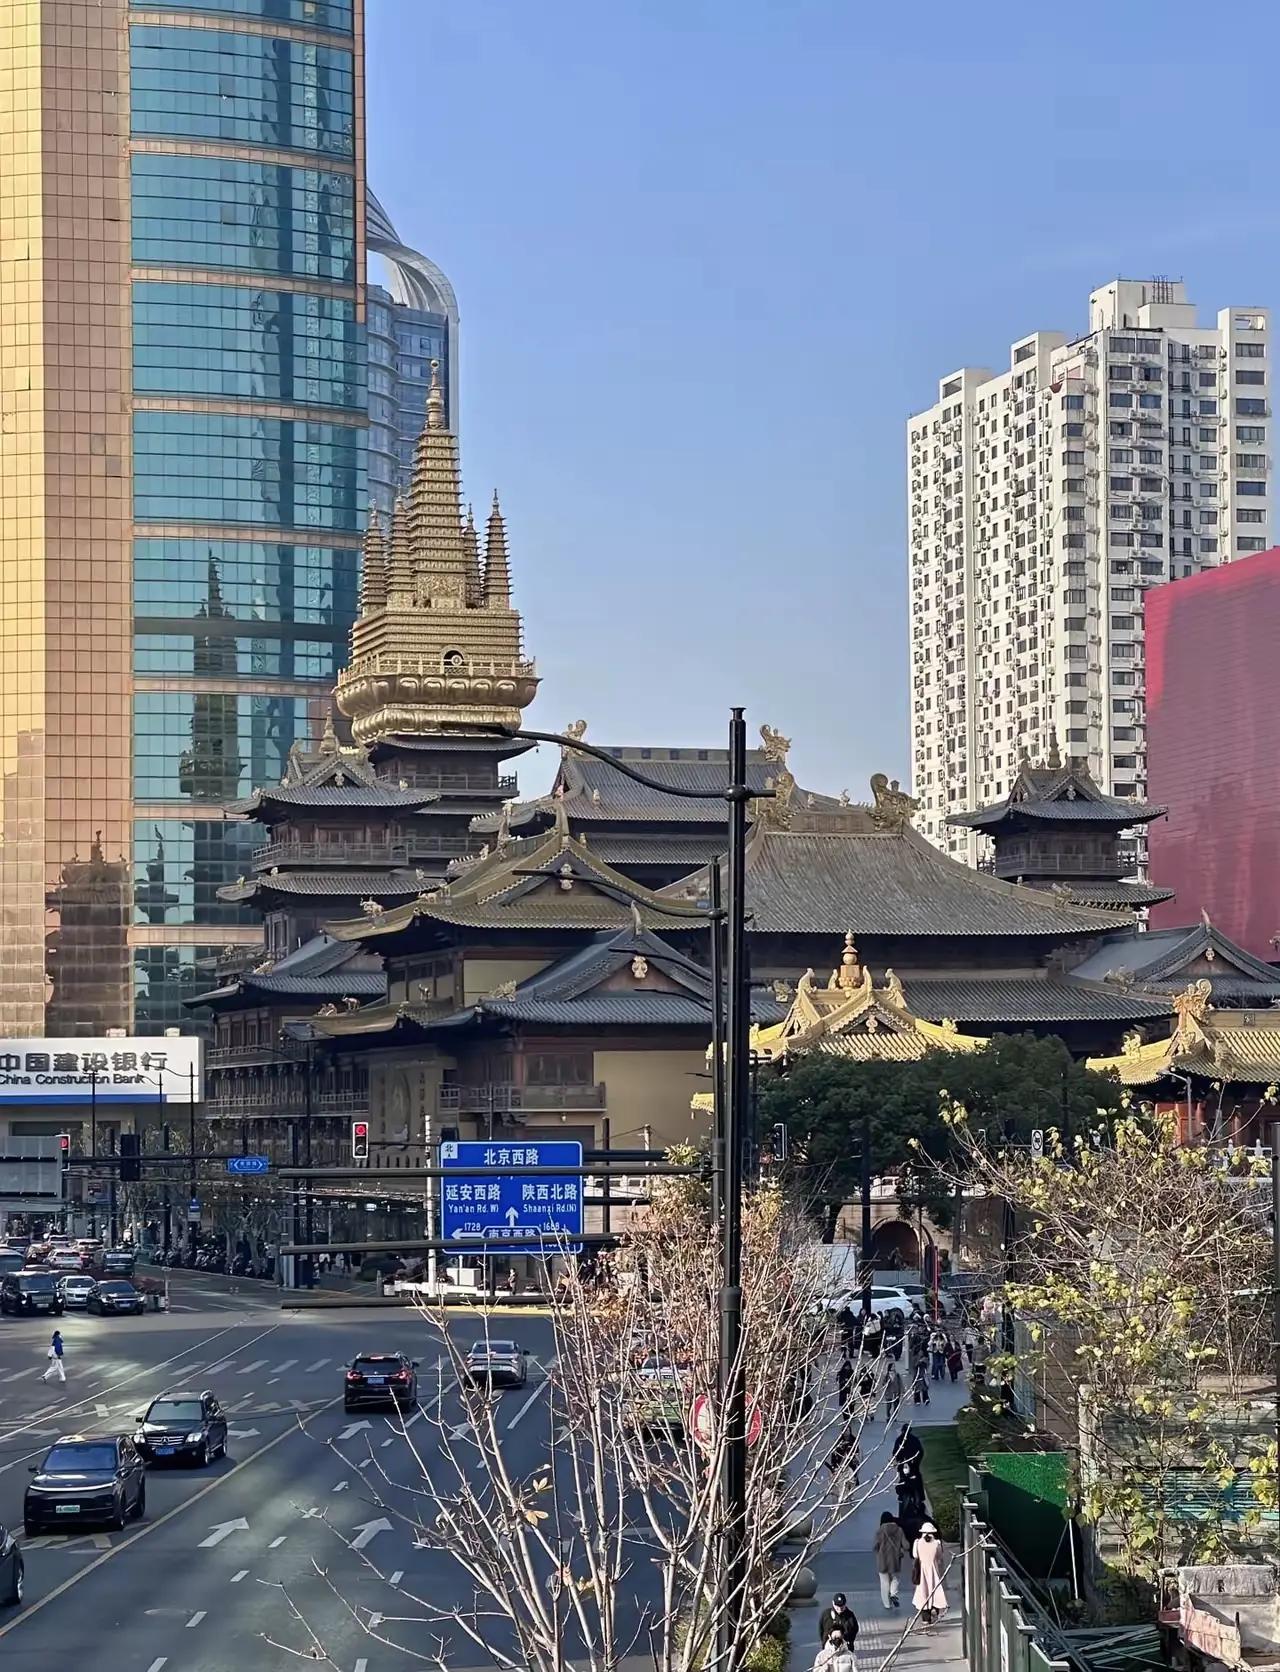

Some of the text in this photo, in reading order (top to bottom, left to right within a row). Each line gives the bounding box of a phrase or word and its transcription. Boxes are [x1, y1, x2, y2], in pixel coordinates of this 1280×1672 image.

[0, 1052, 167, 1072] 中国建设银行
[35, 1074, 110, 1085] Constructon
[113, 1074, 144, 1085] Bank
[445, 1144, 453, 1152] 北
[484, 1148, 539, 1165] 北京西路
[446, 1184, 501, 1201] 延安西路
[522, 1184, 578, 1201] 陕西北路
[448, 1204, 475, 1213] Yan'an
[464, 1222, 481, 1231] 1728
